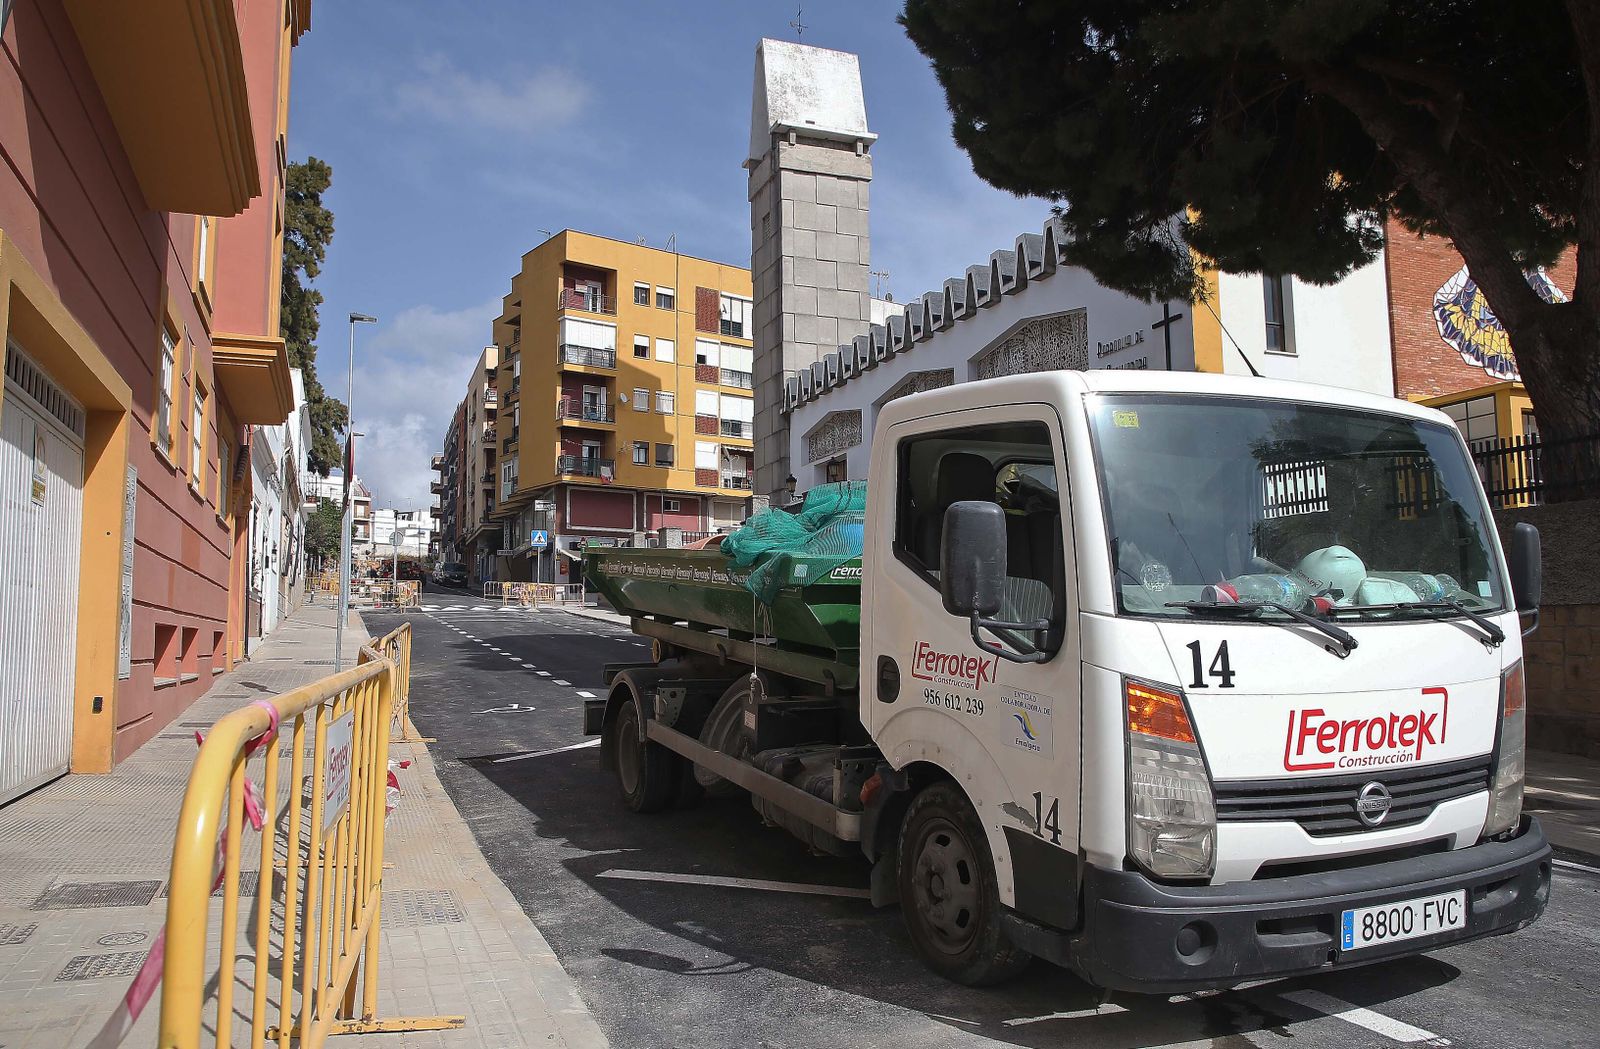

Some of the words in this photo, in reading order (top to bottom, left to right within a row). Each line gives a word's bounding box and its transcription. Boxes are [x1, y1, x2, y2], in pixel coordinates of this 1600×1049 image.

[916, 641, 991, 690] Ferrotek
[1186, 639, 1236, 689] 14
[933, 674, 975, 690] Construcción
[923, 688, 941, 706] 956
[944, 693, 962, 711] 612
[965, 697, 984, 716] 239
[1000, 696, 1043, 713] COLABORADORA
[1043, 707, 1051, 716] DE
[1013, 690, 1037, 703] ENTIDAD
[1295, 708, 1438, 760] Ferrotek
[1338, 750, 1414, 769] Construcción
[1362, 800, 1392, 810] NISSAN
[1032, 791, 1063, 846] 14
[1362, 906, 1414, 942] 8800
[1424, 897, 1459, 930] FVC
[1345, 934, 1352, 943] E
